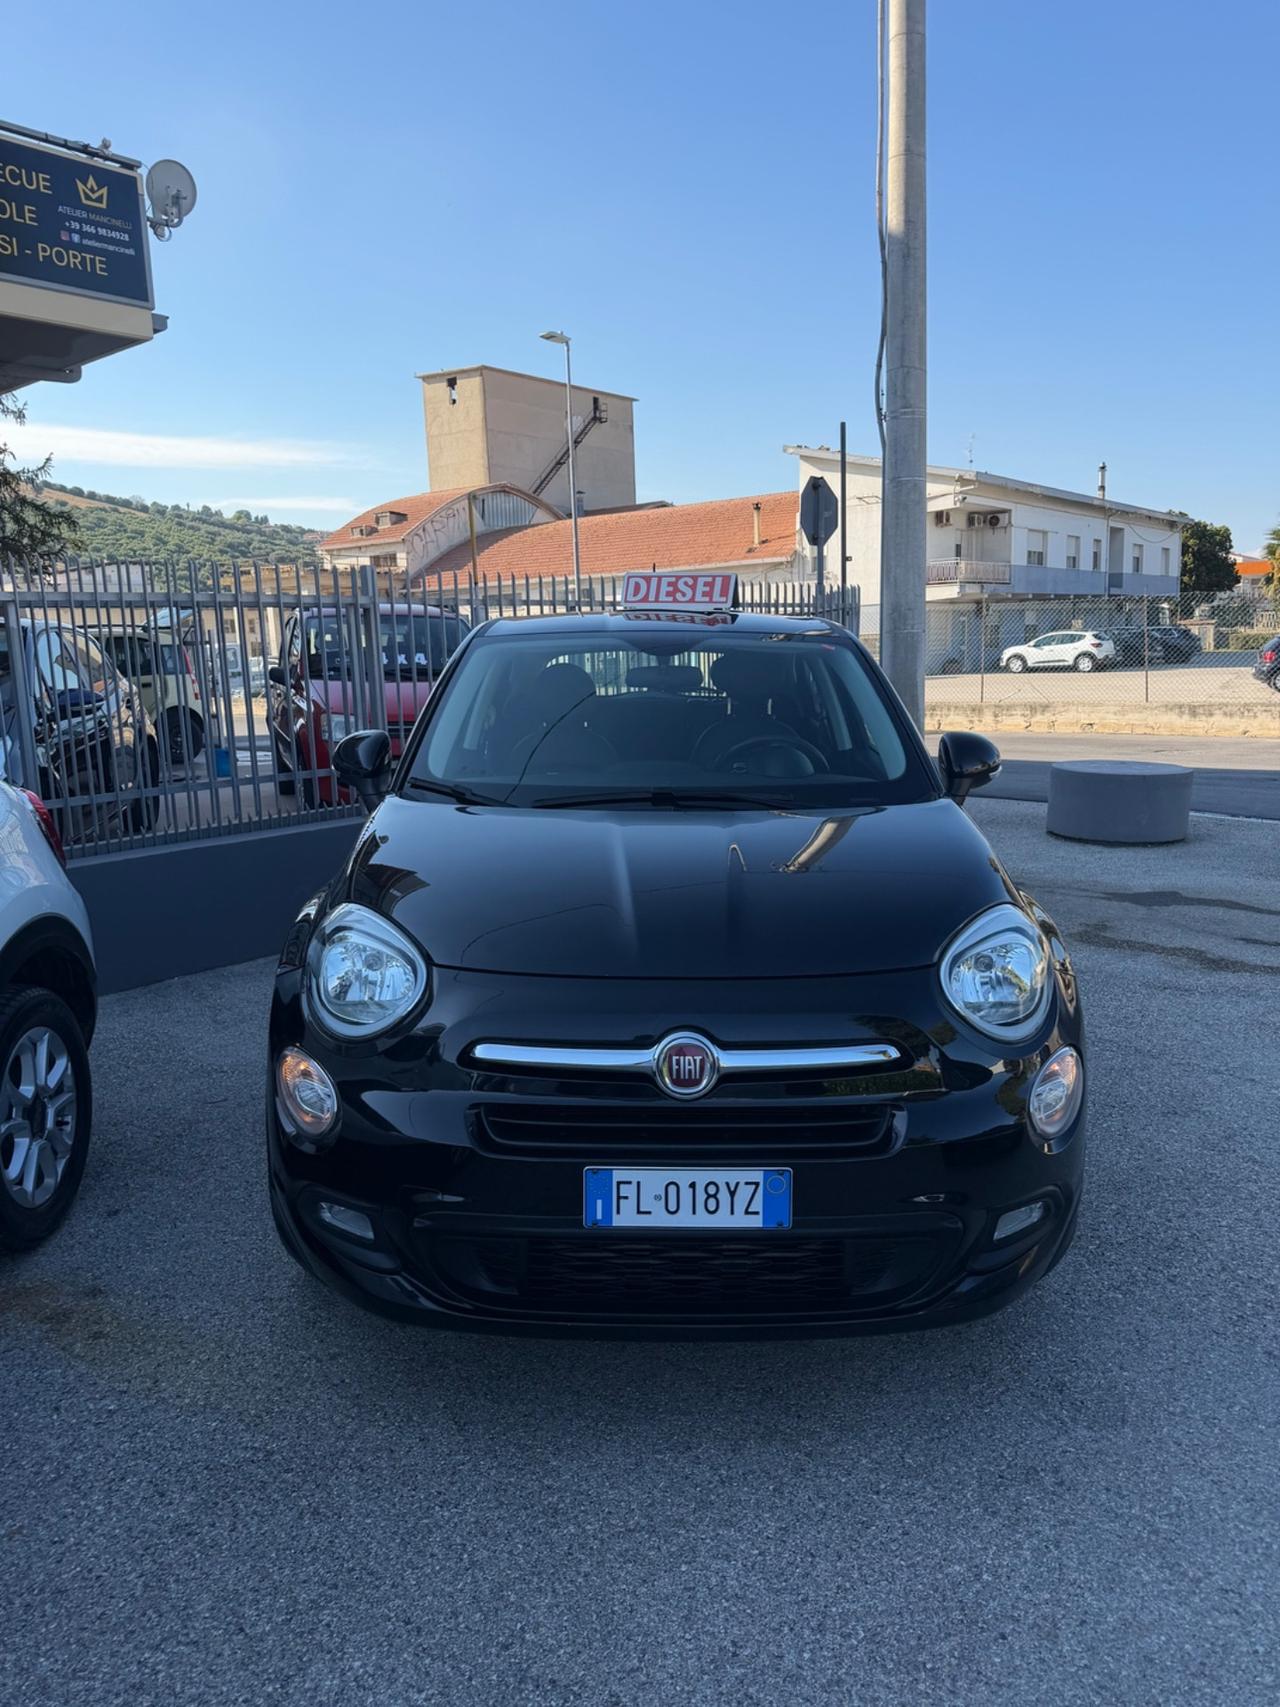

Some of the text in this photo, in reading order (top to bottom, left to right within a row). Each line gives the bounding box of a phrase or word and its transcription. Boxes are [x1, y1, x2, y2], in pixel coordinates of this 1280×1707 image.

[57, 205, 88, 218] ATELIER
[65, 220, 80, 230] +39
[81, 223, 96, 234] 366
[37, 242, 108, 276] PORTE
[625, 576, 728, 603] DIESEL
[672, 1055, 703, 1080] FIAT
